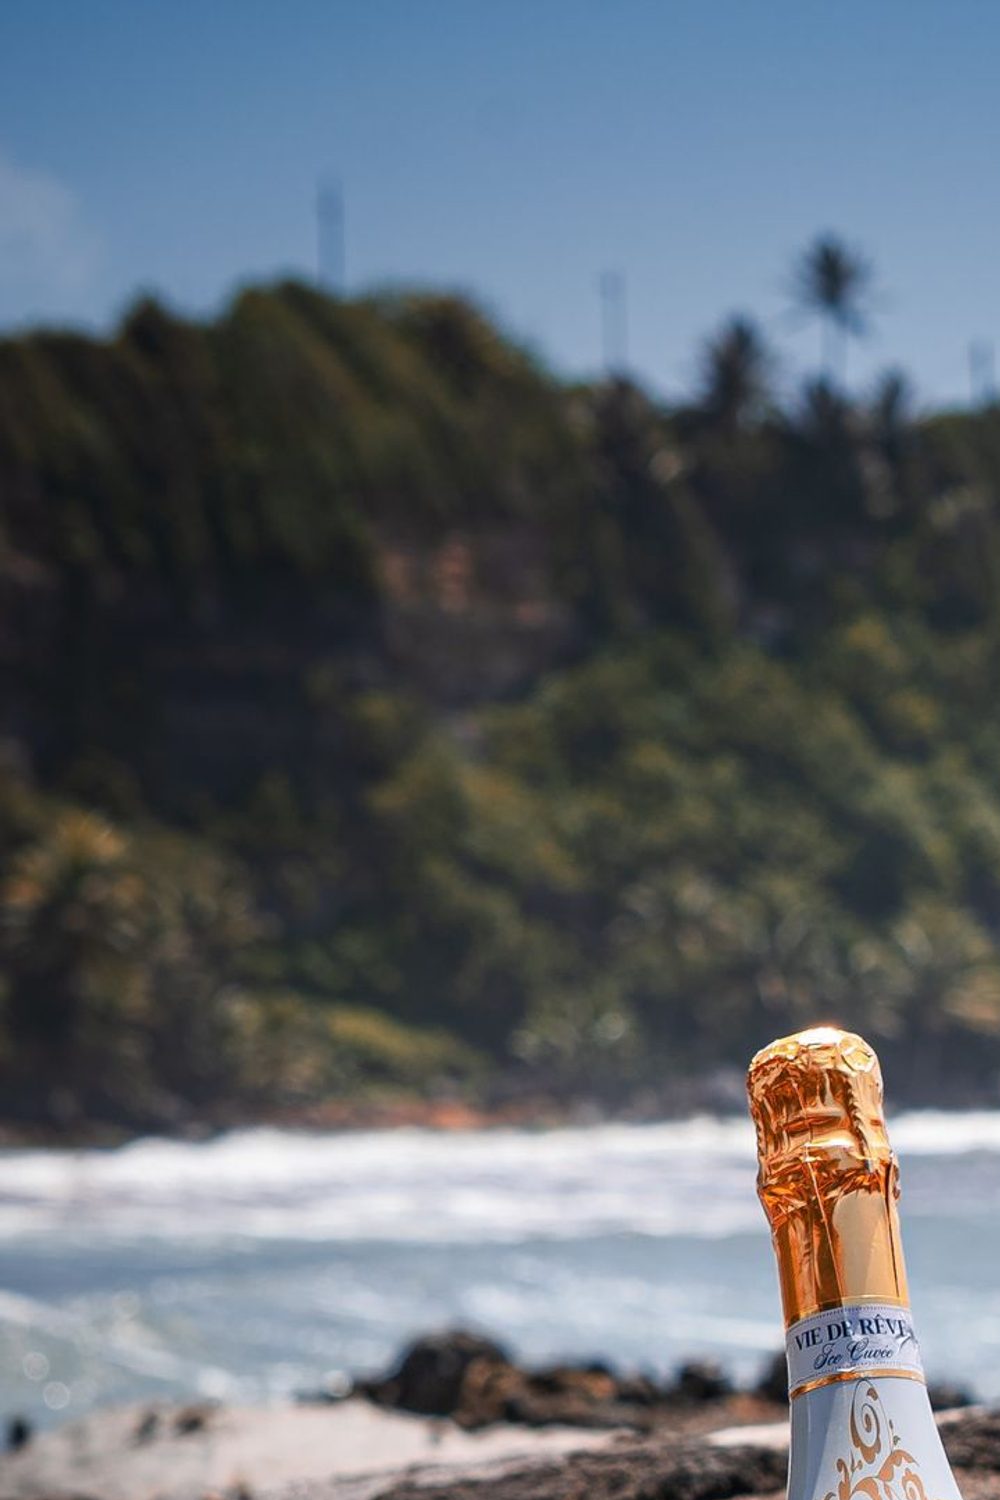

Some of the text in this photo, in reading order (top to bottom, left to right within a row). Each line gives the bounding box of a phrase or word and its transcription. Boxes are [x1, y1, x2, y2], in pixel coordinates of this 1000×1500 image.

[795, 1327, 821, 1350] VIE
[827, 1321, 854, 1341] DE
[813, 1337, 893, 1370] Ice Cuvée
